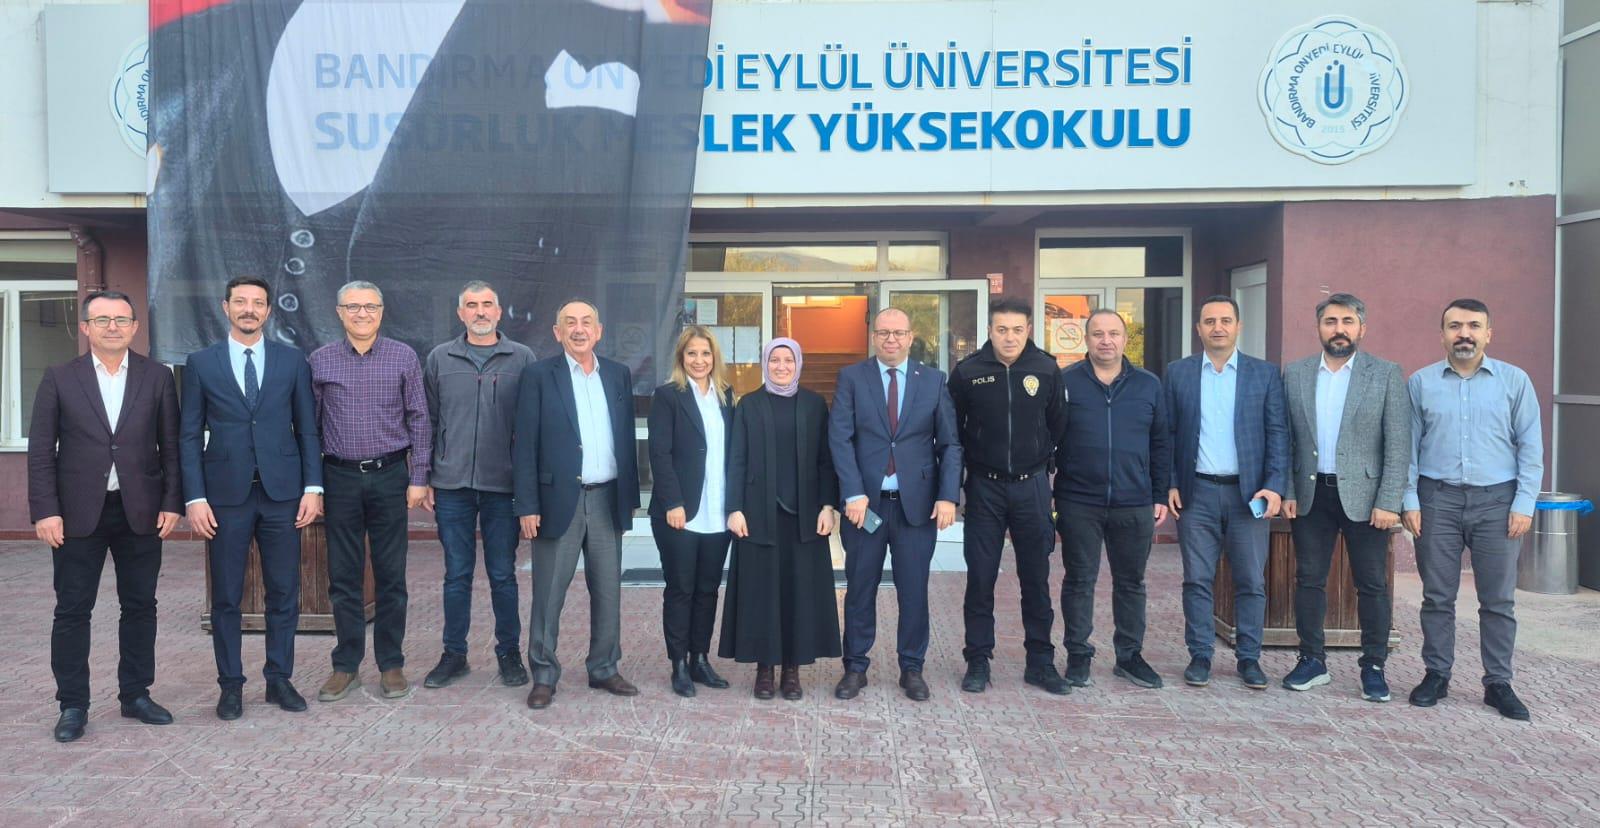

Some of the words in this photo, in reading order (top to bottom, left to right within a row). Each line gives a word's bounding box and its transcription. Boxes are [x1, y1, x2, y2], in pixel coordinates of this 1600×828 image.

[736, 43, 873, 91] EYLÜL
[883, 35, 1194, 91] ÜNİVERSİTESİ
[806, 101, 1192, 152] YÜKSEKOKULU
[1288, 75, 1316, 129] BANDIRMA
